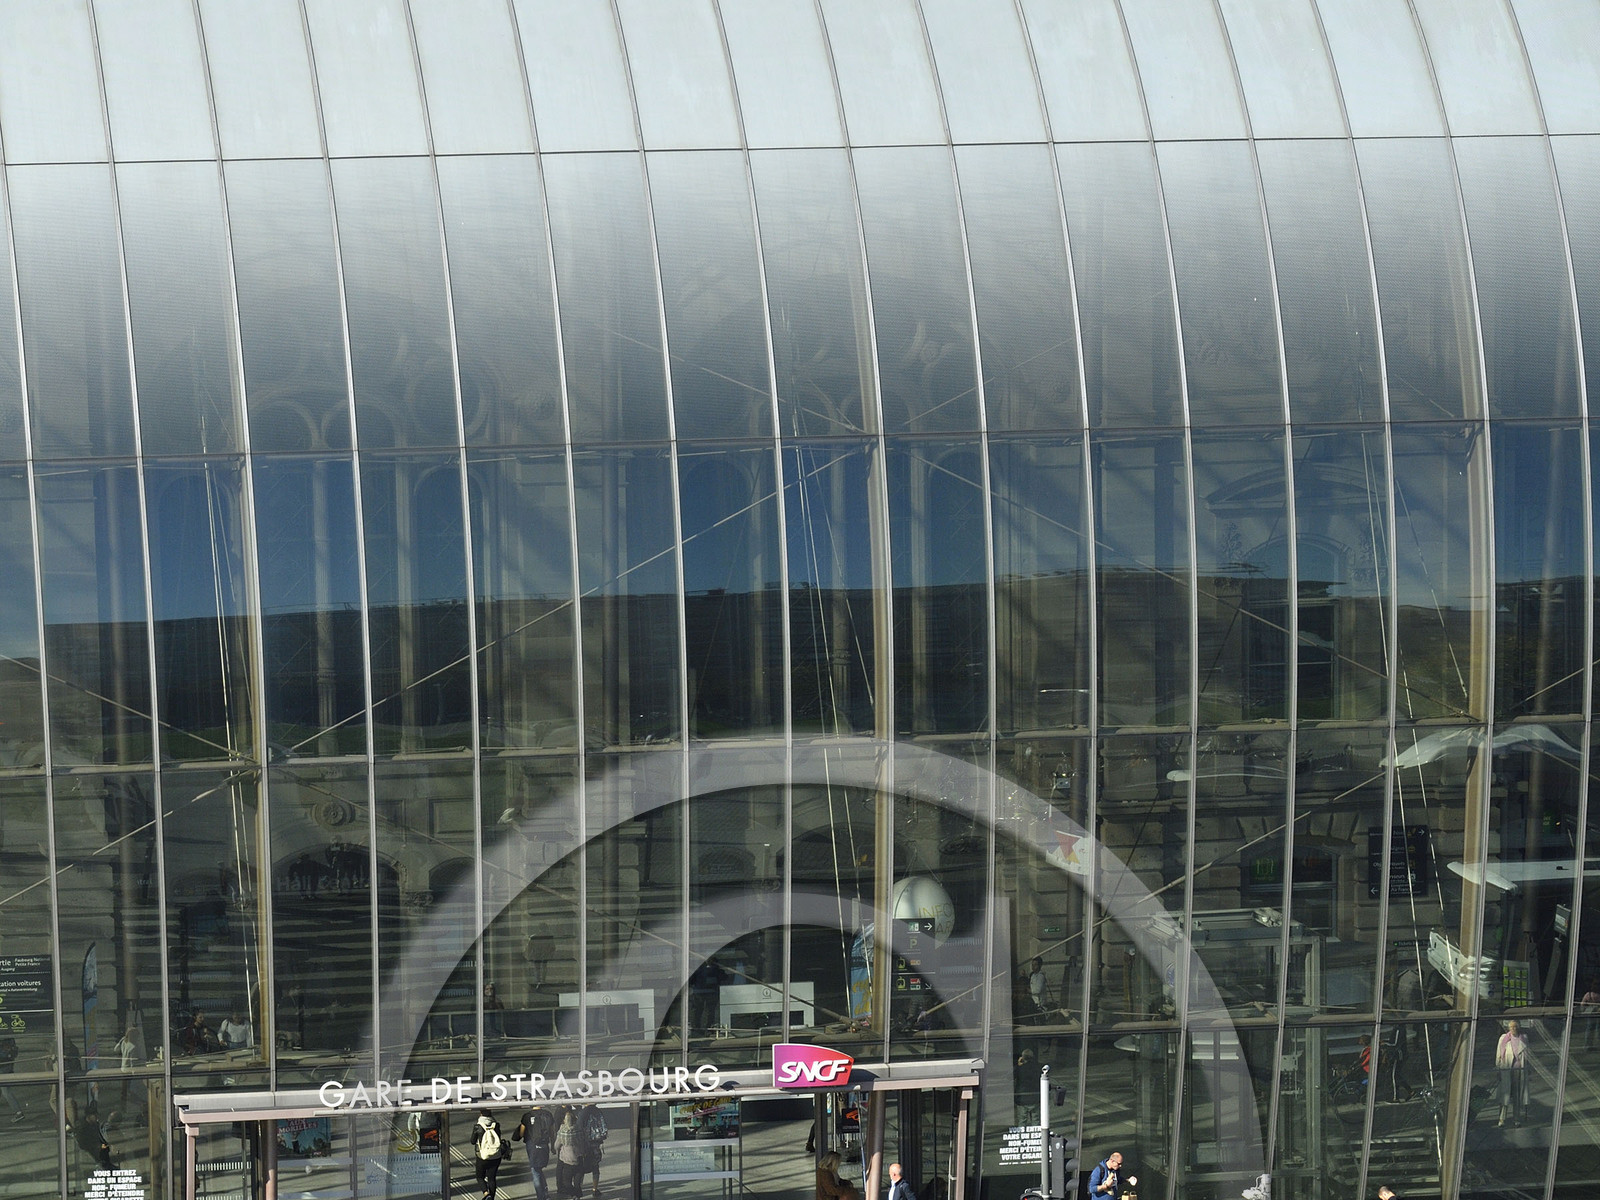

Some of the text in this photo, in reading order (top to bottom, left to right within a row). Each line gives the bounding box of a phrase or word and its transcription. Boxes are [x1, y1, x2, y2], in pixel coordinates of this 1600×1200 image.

[319, 1064, 720, 1108] GARE DE STRASBOURG
[778, 1059, 850, 1083] SNCF
